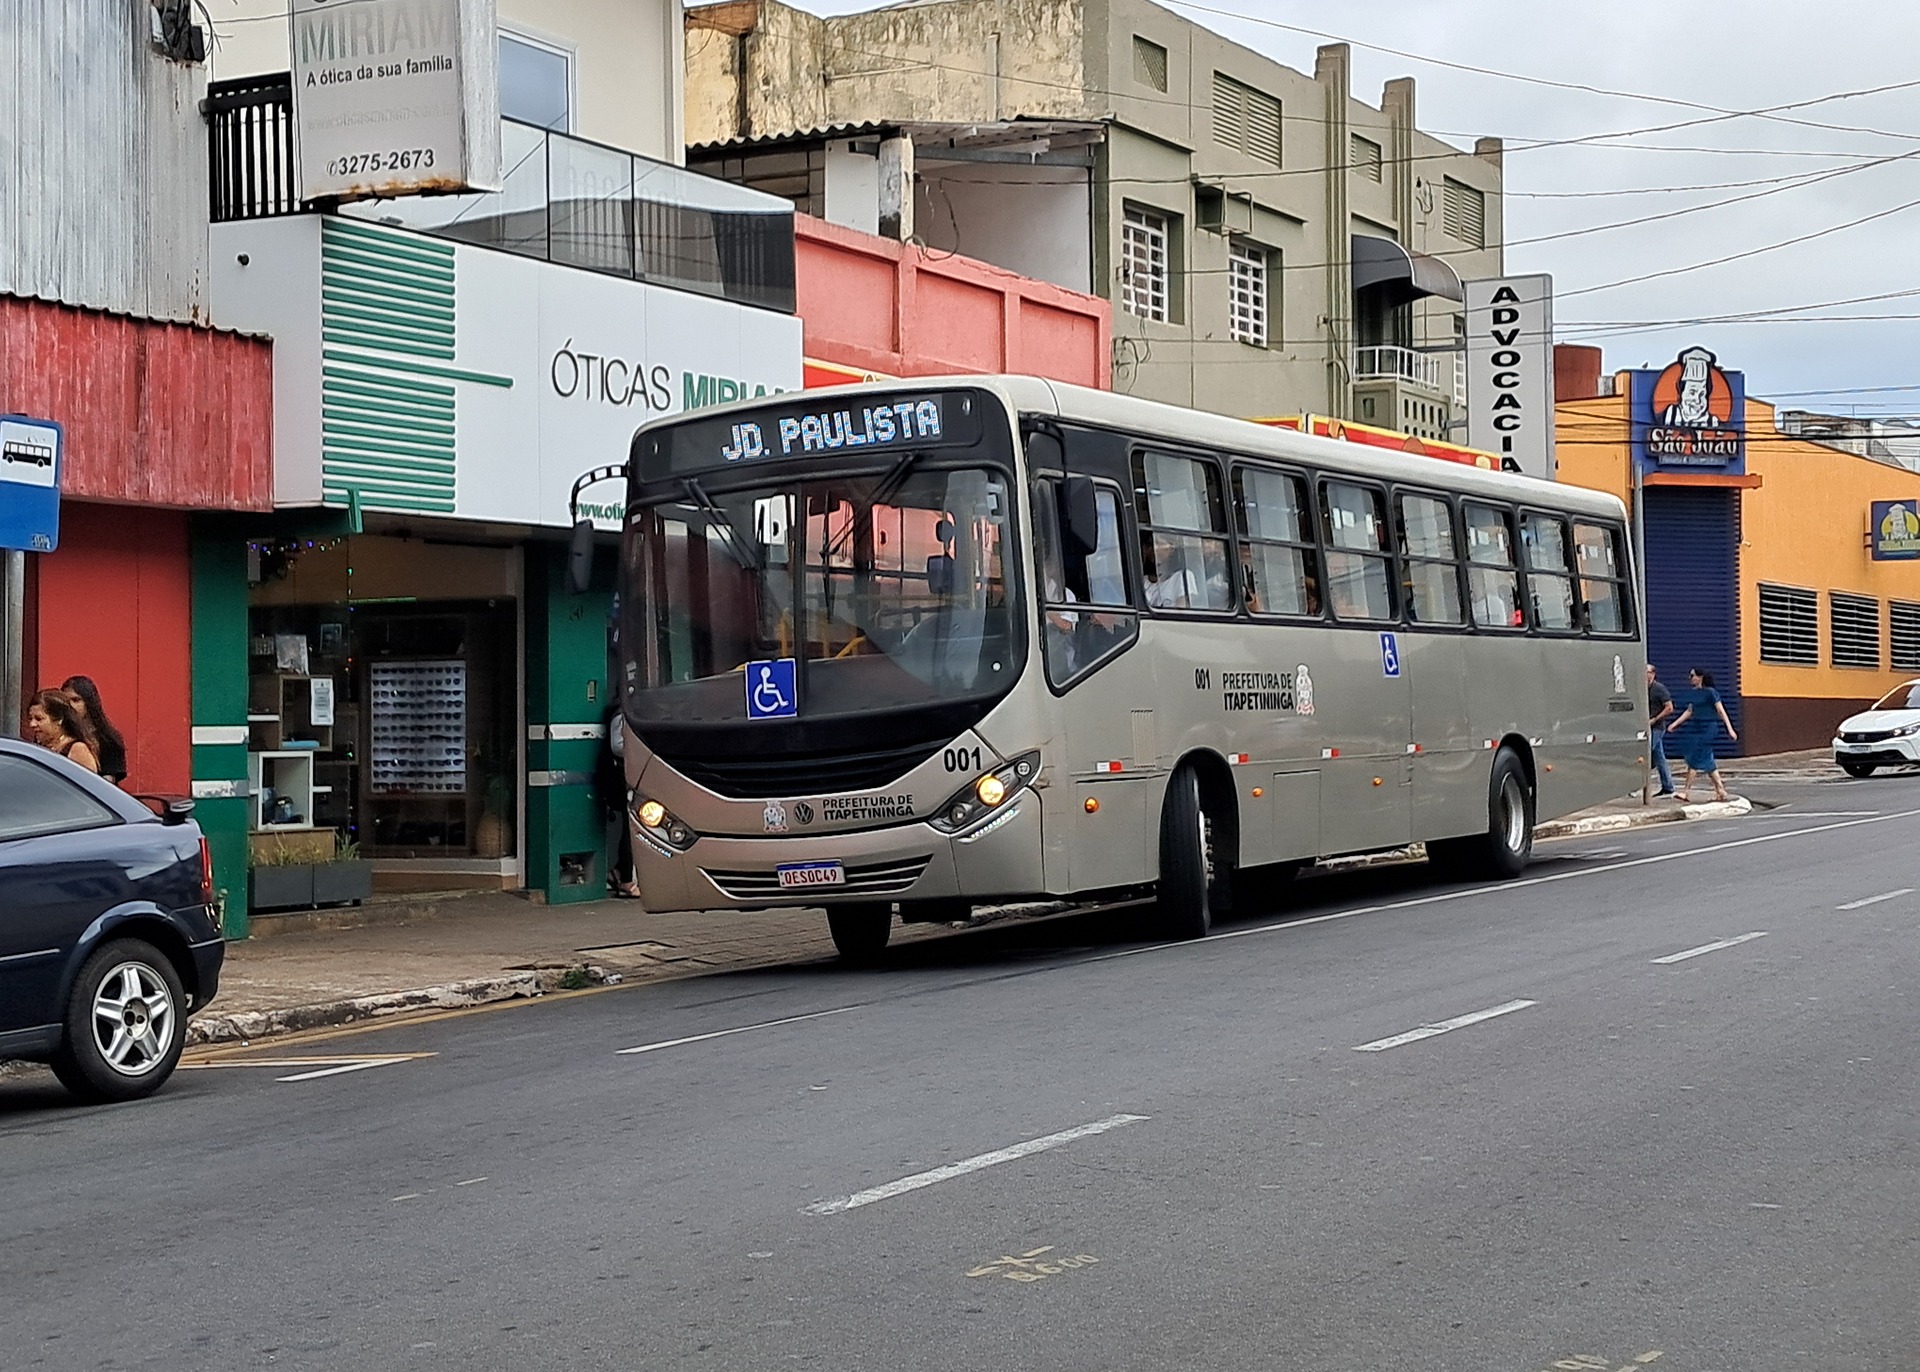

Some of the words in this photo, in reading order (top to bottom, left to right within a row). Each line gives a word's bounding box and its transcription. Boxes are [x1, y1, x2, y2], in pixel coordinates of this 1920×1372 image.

[306, 71, 317, 88] A
[320, 69, 353, 86] ótica
[357, 64, 373, 80] da
[377, 63, 401, 78] sua
[406, 54, 453, 75] família
[338, 148, 434, 176] 3275-2673
[551, 337, 672, 411] ÓTICAS
[1490, 286, 1523, 473] ADVOCACIA
[722, 423, 770, 460] JD.
[779, 400, 941, 453] PAULISTA
[1650, 428, 1685, 454] São
[1692, 429, 1737, 455] João
[1194, 668, 1211, 689] 001
[1222, 672, 1279, 689] PREFEITURA
[1280, 672, 1293, 689] DE
[1223, 692, 1294, 711] ITAPETININGA
[943, 746, 982, 773] 001
[822, 796, 895, 810] PREFEITURA
[897, 794, 914, 806] DE
[823, 805, 915, 821] ITAPETININGA
